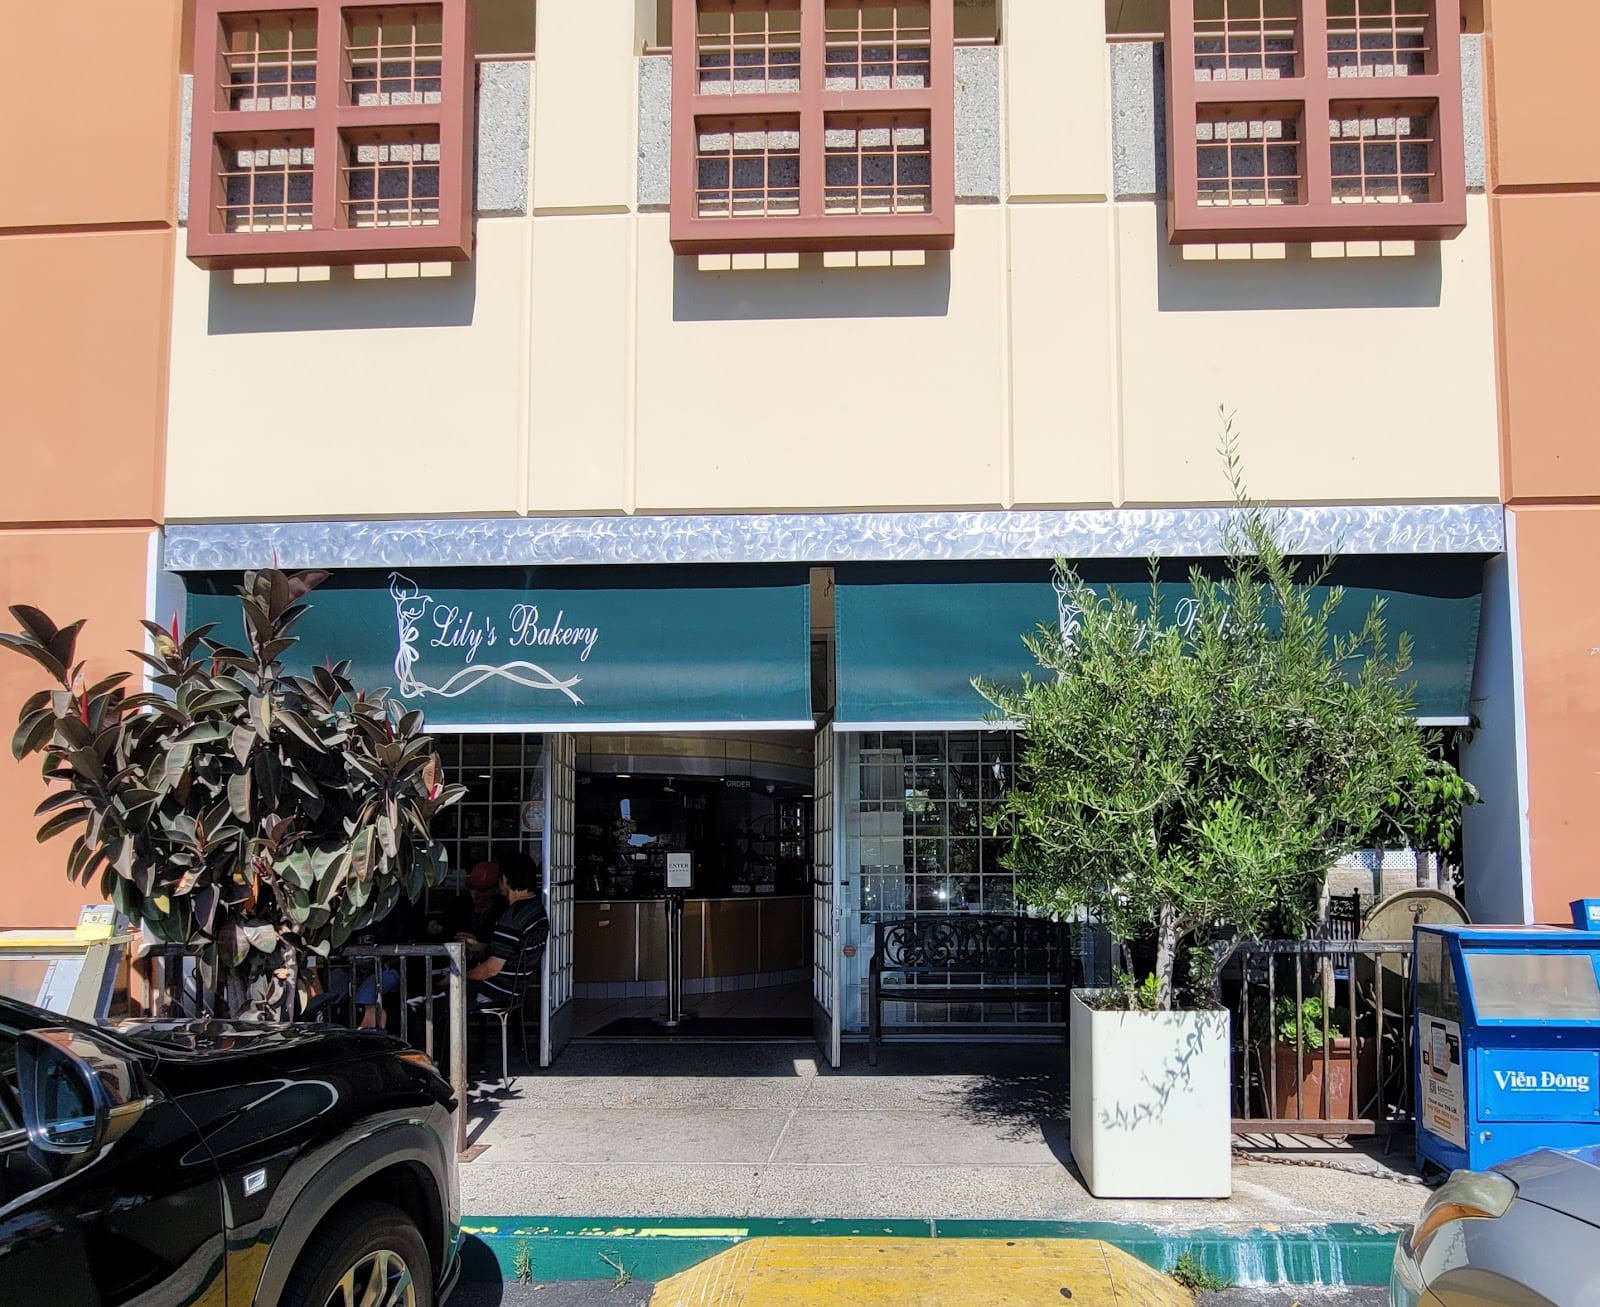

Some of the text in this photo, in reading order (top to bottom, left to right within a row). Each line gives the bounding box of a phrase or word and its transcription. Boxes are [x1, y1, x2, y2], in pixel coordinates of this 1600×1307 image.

[430, 603, 599, 664] Lily's Bakery
[726, 779, 751, 788] ORDER
[1493, 1070, 1590, 1093] Viễn Đông
